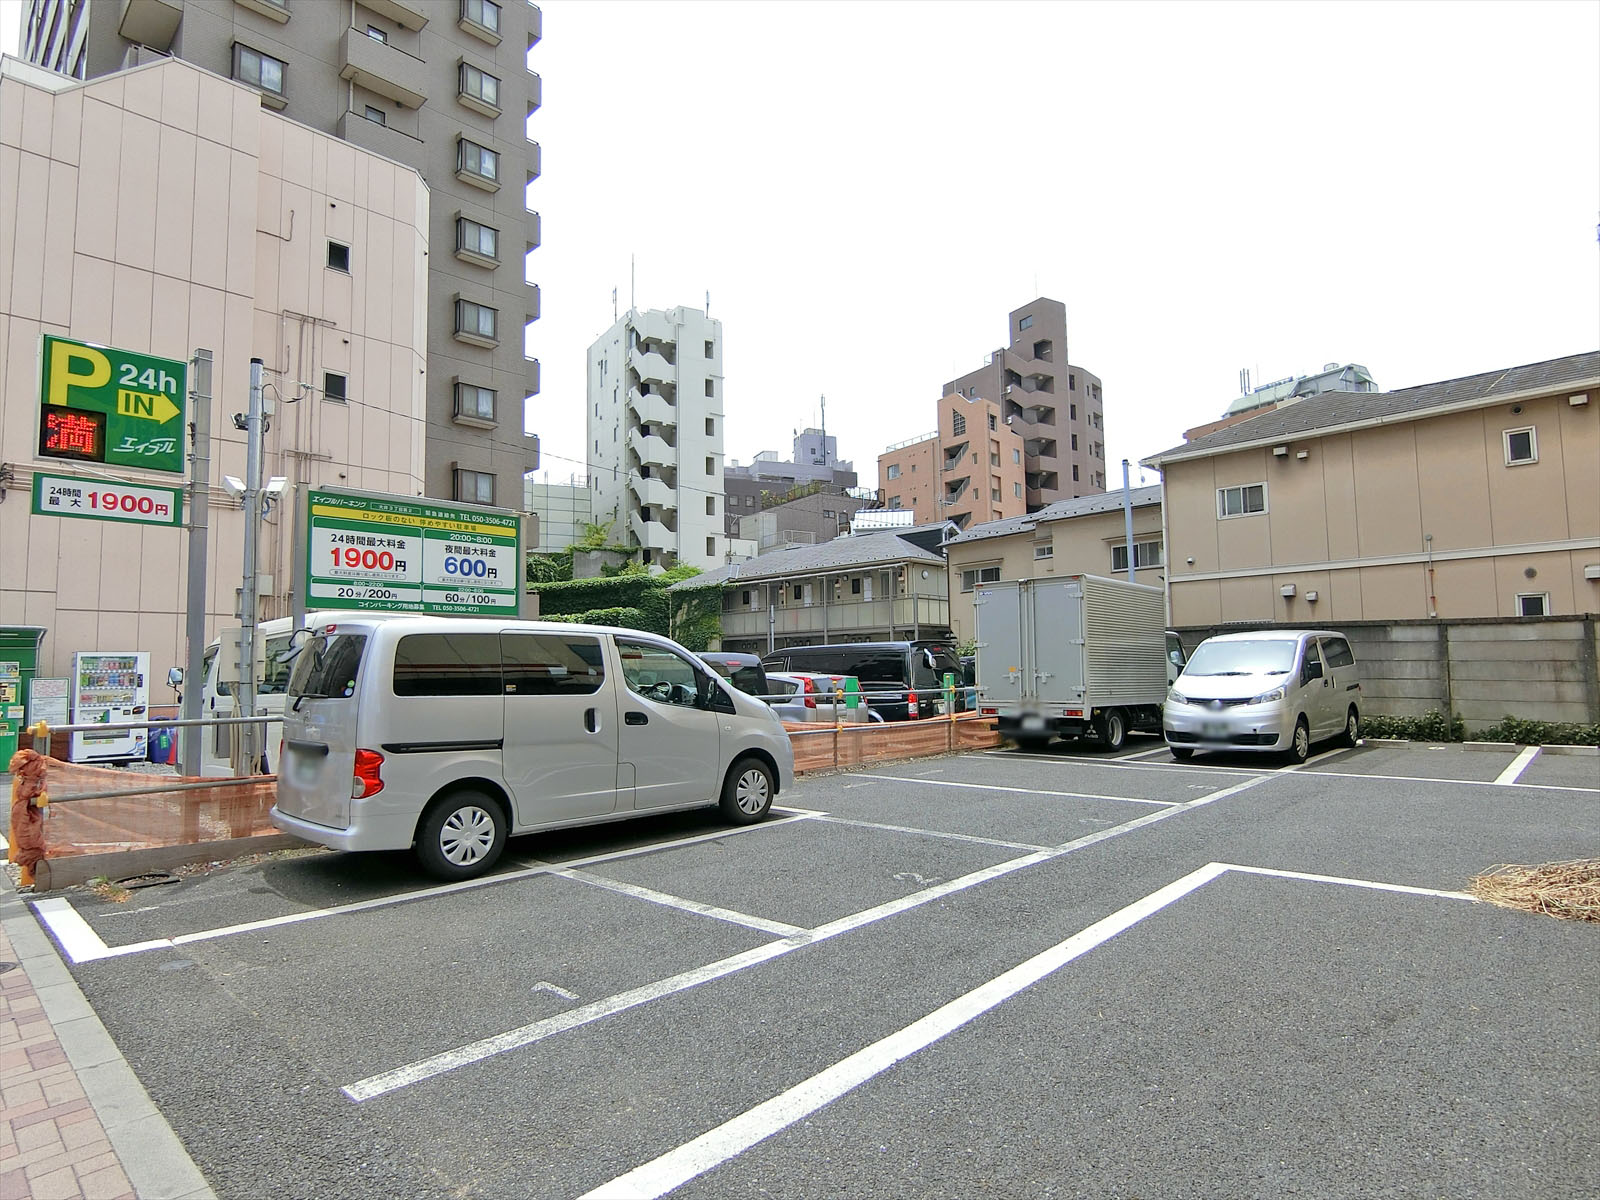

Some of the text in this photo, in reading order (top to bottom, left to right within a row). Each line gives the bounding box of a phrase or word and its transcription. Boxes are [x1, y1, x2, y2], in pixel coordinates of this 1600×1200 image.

[50, 341, 112, 406] P
[119, 363, 177, 394] 24h
[124, 392, 154, 417] IN
[46, 413, 97, 454] 満
[112, 436, 177, 456] エイブル
[49, 486, 82, 498] 24時間
[87, 491, 169, 516] 1900円
[460, 513, 516, 527] TEL 050-3506-4721
[330, 533, 406, 550] 24時間最大料金
[444, 545, 497, 558] 夜間最大料金
[330, 547, 407, 571] 1900円
[444, 556, 498, 578] 600円
